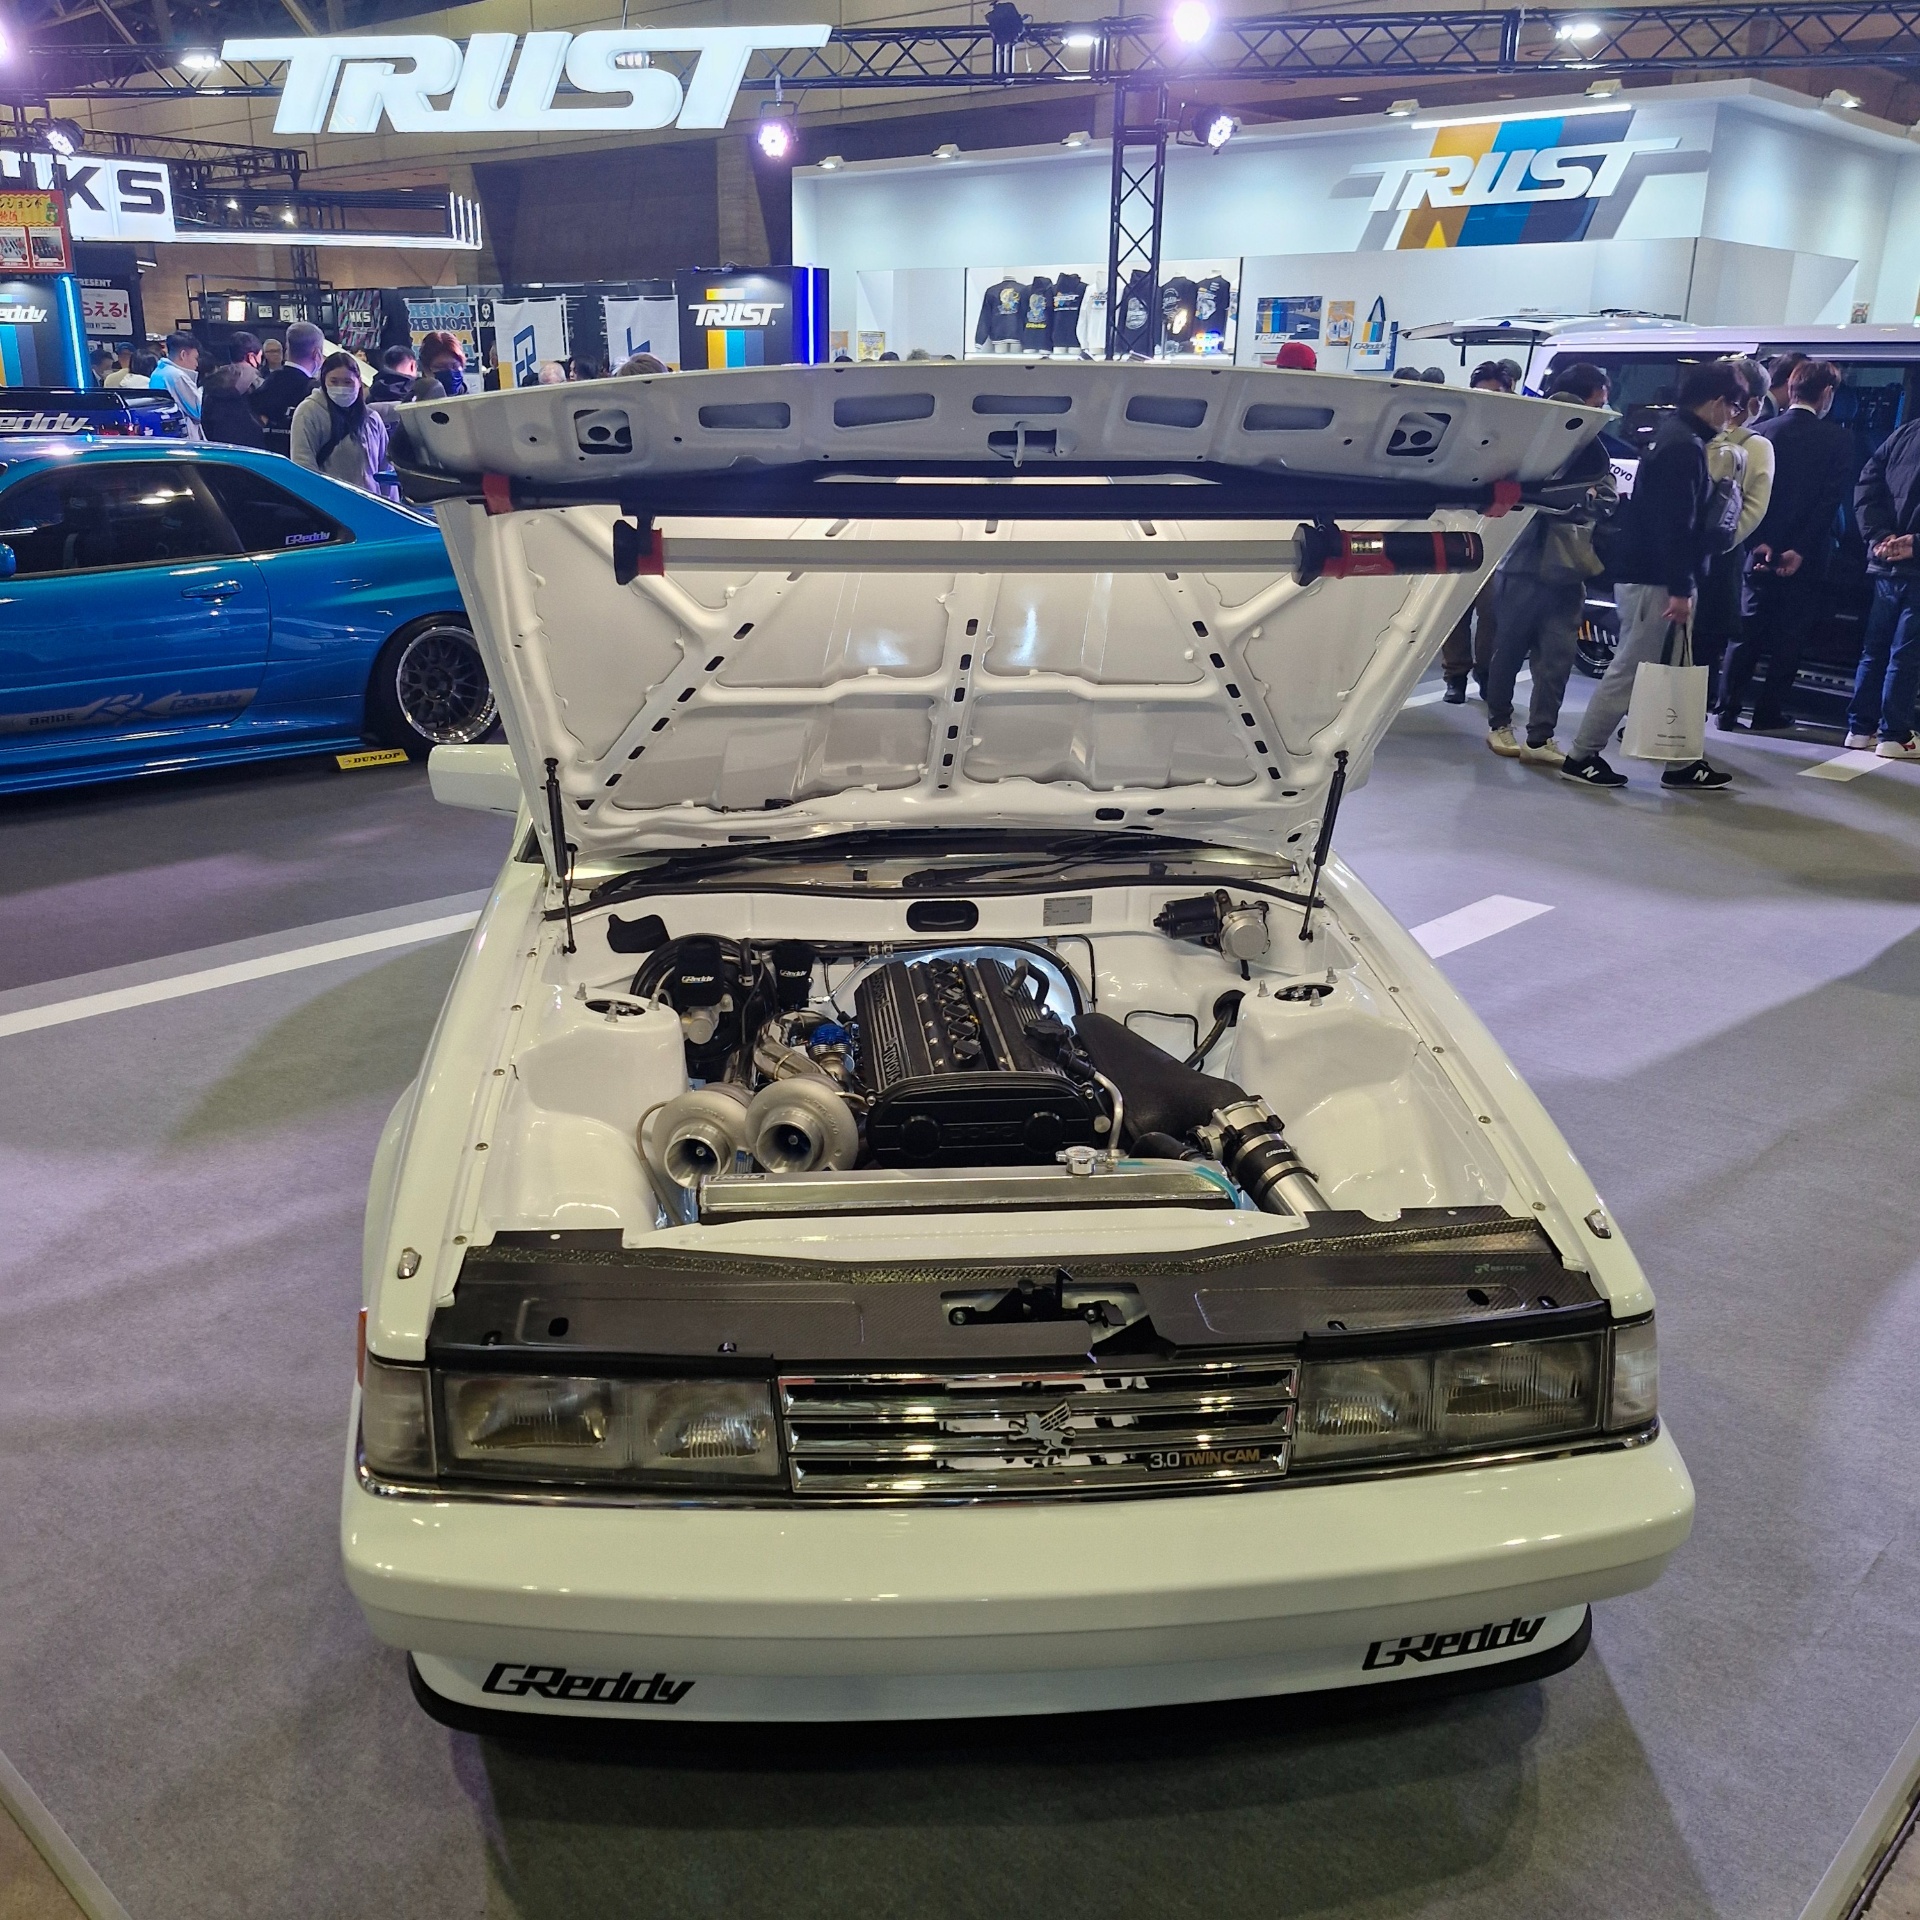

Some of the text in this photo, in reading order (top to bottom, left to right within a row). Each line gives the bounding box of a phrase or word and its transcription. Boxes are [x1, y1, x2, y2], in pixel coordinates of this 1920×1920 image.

[221, 24, 832, 134] TRUST
[1349, 136, 1682, 212] TRUST
[350, 311, 372, 323] HKS
[688, 303, 784, 326] TRUST
[1254, 333, 1295, 341] TRUST
[285, 531, 330, 545] GReddy
[29, 713, 76, 726] BRIDE
[353, 752, 400, 764] DUNLOP
[1150, 1449, 1260, 1468] 3.0 TWIN CAM
[1361, 1615, 1547, 1671] GReddy
[481, 1662, 696, 1705] GReddy
